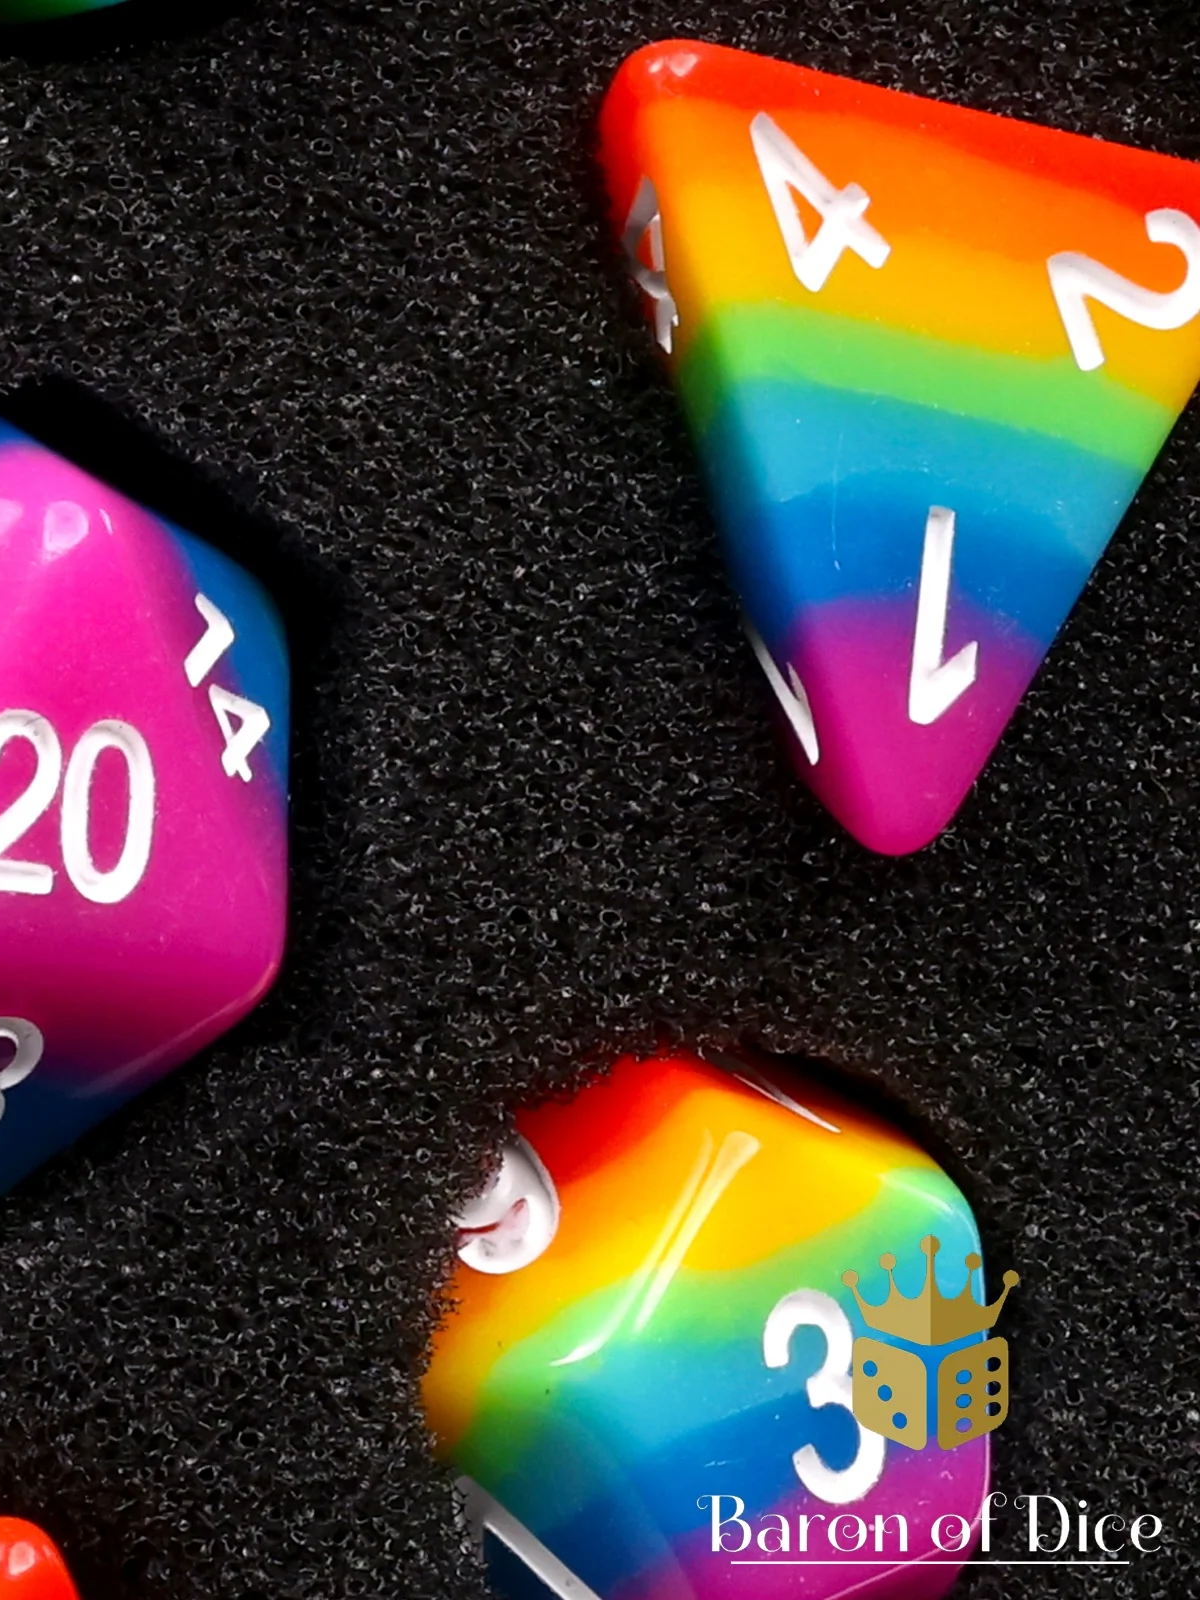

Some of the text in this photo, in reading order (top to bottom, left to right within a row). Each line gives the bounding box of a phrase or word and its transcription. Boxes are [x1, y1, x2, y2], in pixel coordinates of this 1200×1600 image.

[750, 111, 891, 292] 4
[1046, 207, 1200, 372] 2
[908, 505, 978, 724] 1
[763, 1287, 886, 1504] 3
